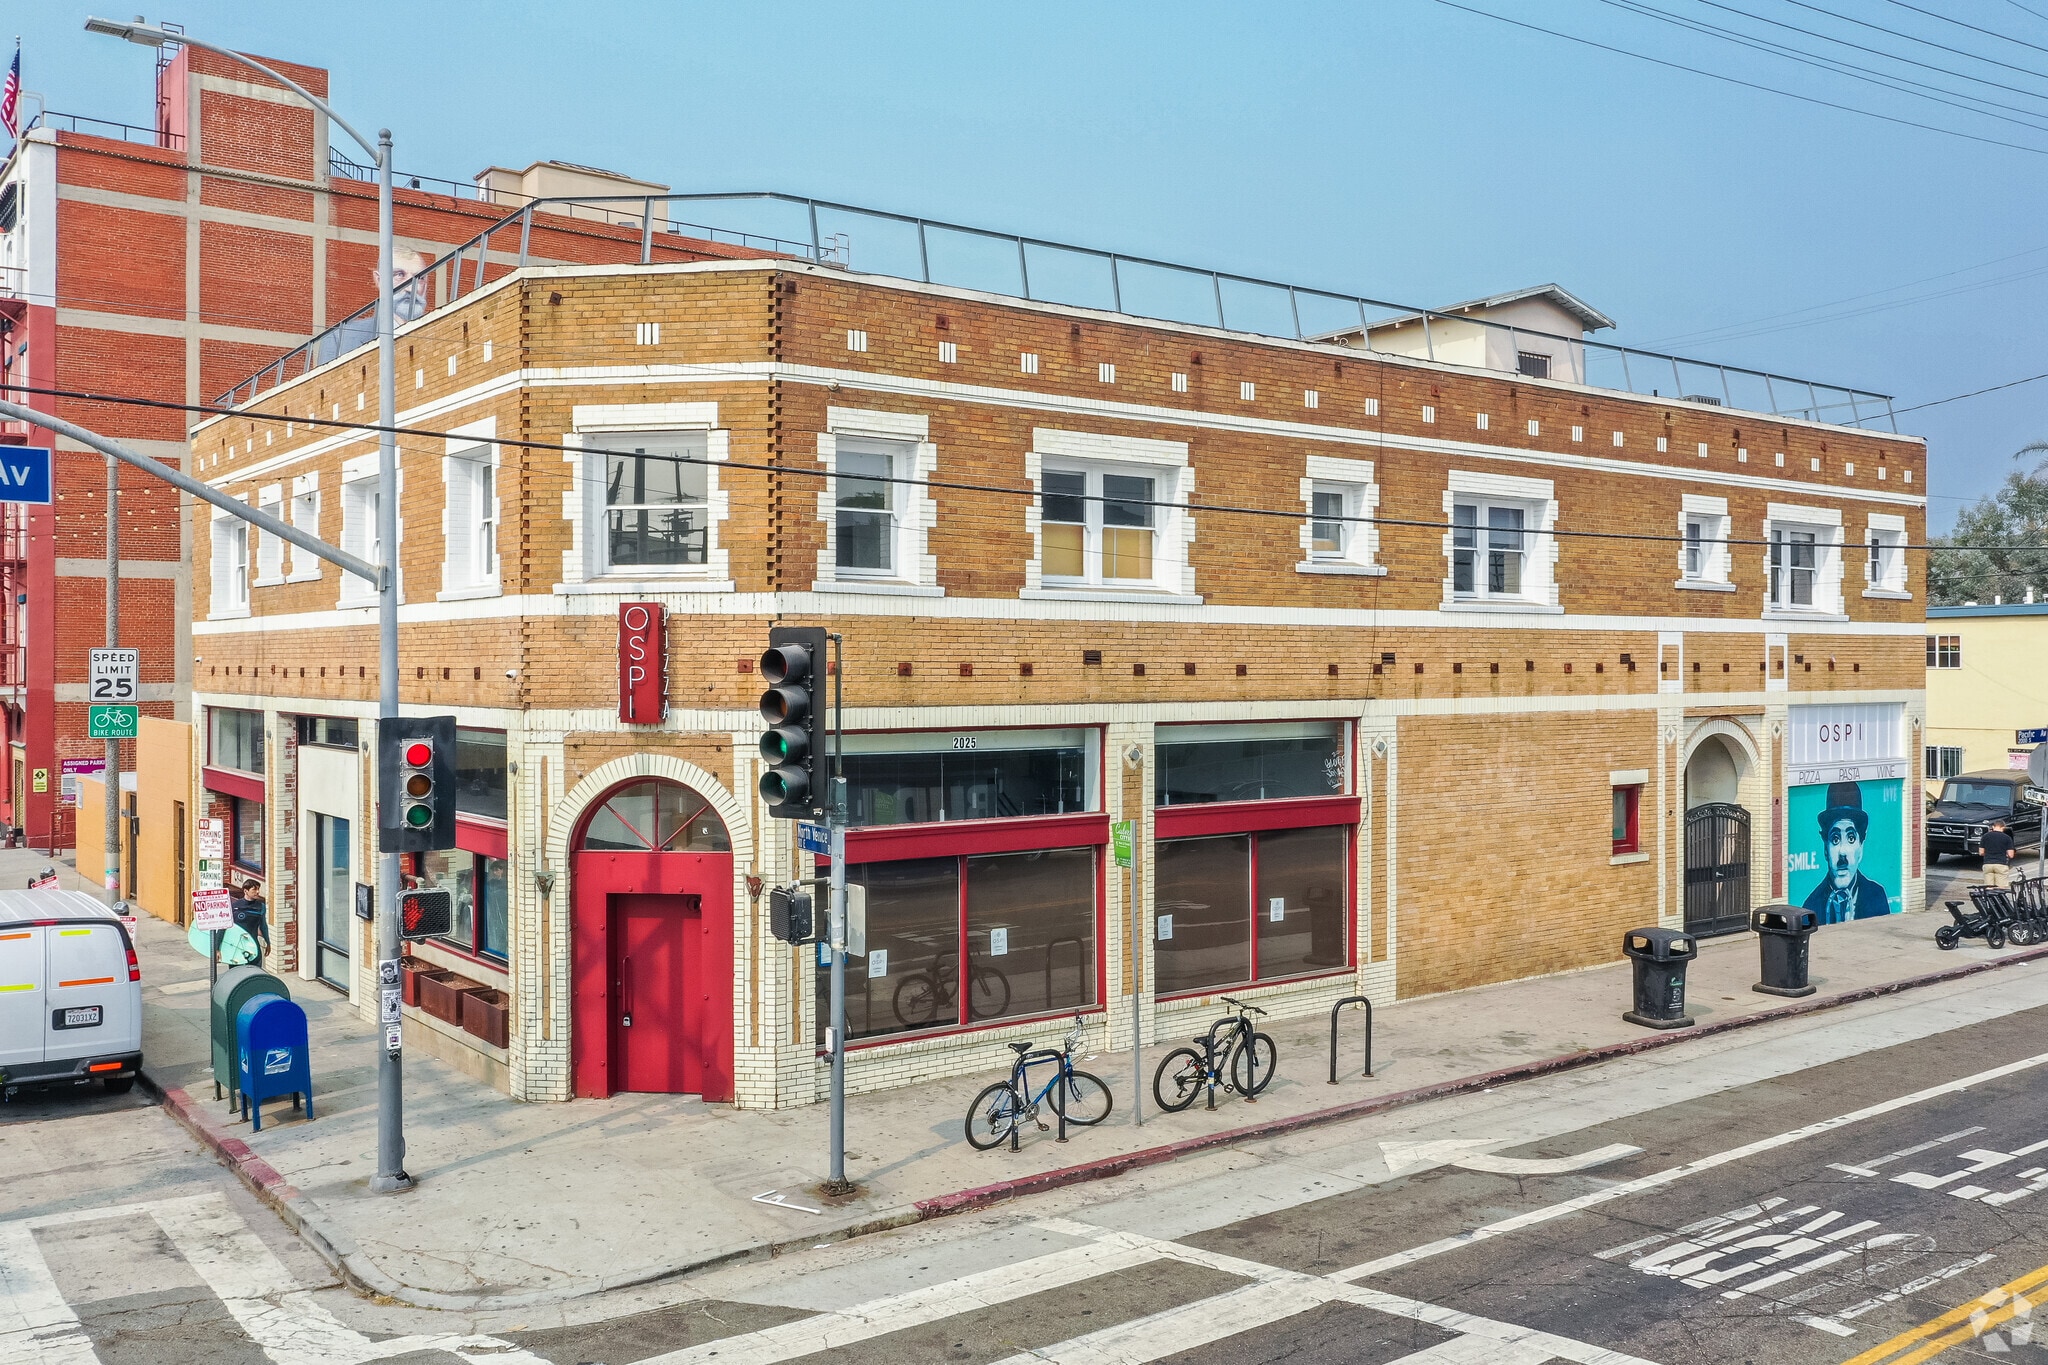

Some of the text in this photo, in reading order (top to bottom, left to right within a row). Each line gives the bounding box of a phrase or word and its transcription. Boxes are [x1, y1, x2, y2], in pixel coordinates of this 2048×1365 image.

[93, 653, 135, 662] SPEED
[625, 606, 649, 718] OSPI
[97, 665, 131, 674] LIMIT
[94, 678, 133, 698] 25
[1819, 723, 1862, 743] OSPI
[953, 737, 976, 749] 2025
[1799, 764, 1896, 784] PIZZA PASTA WINE
[1788, 851, 1820, 873] SMILE.
[200, 872, 221, 880] PARKING
[195, 900, 229, 912] NO PARKING
